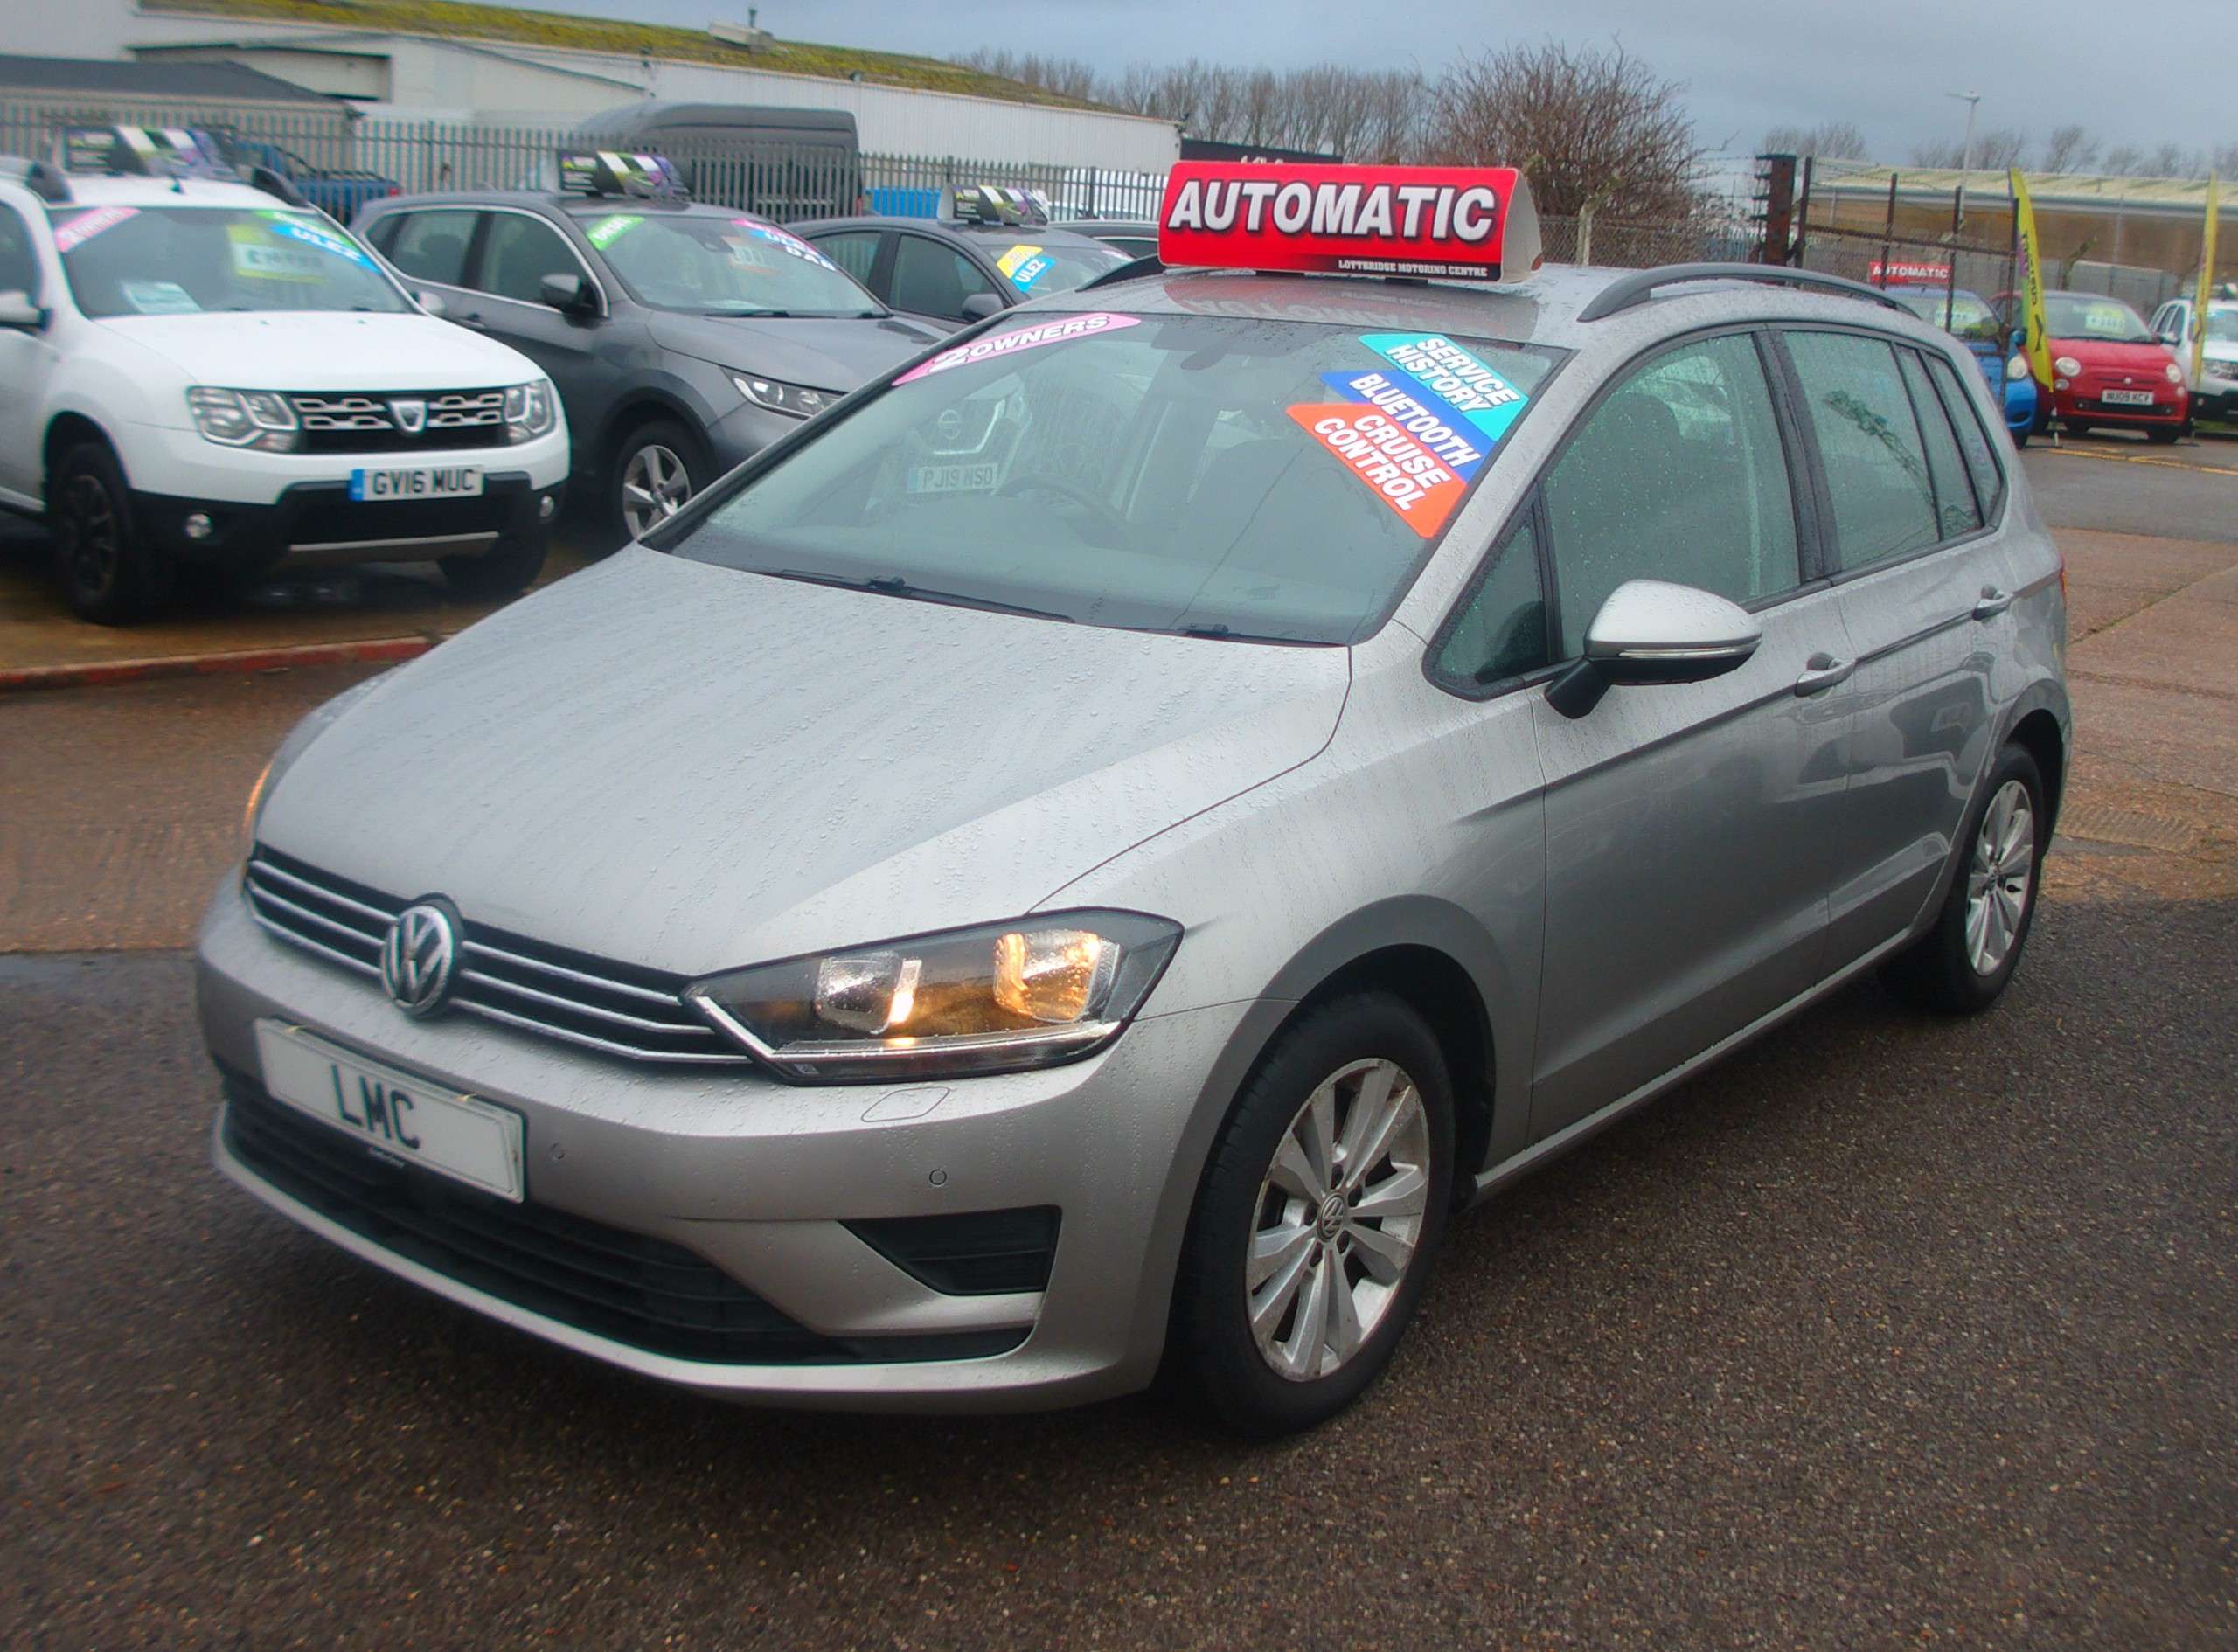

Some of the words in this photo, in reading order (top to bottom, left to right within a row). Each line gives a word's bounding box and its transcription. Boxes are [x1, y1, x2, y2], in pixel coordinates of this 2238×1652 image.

[1167, 180, 1496, 242] AUTOMATIC
[1015, 259, 1046, 283] ULEZ
[1399, 263, 1447, 274] MOTORING
[1448, 266, 1488, 276] CENTRE
[1385, 344, 1493, 413] HISTORY
[1416, 337, 1520, 406] SERVICE
[1348, 373, 1482, 468] BLUETOOTH
[1354, 415, 1452, 489] CRUISE
[373, 471, 425, 495] GV16
[433, 469, 475, 492] MUC
[1314, 418, 1426, 511] CONTROL
[330, 1063, 420, 1150] LMC
